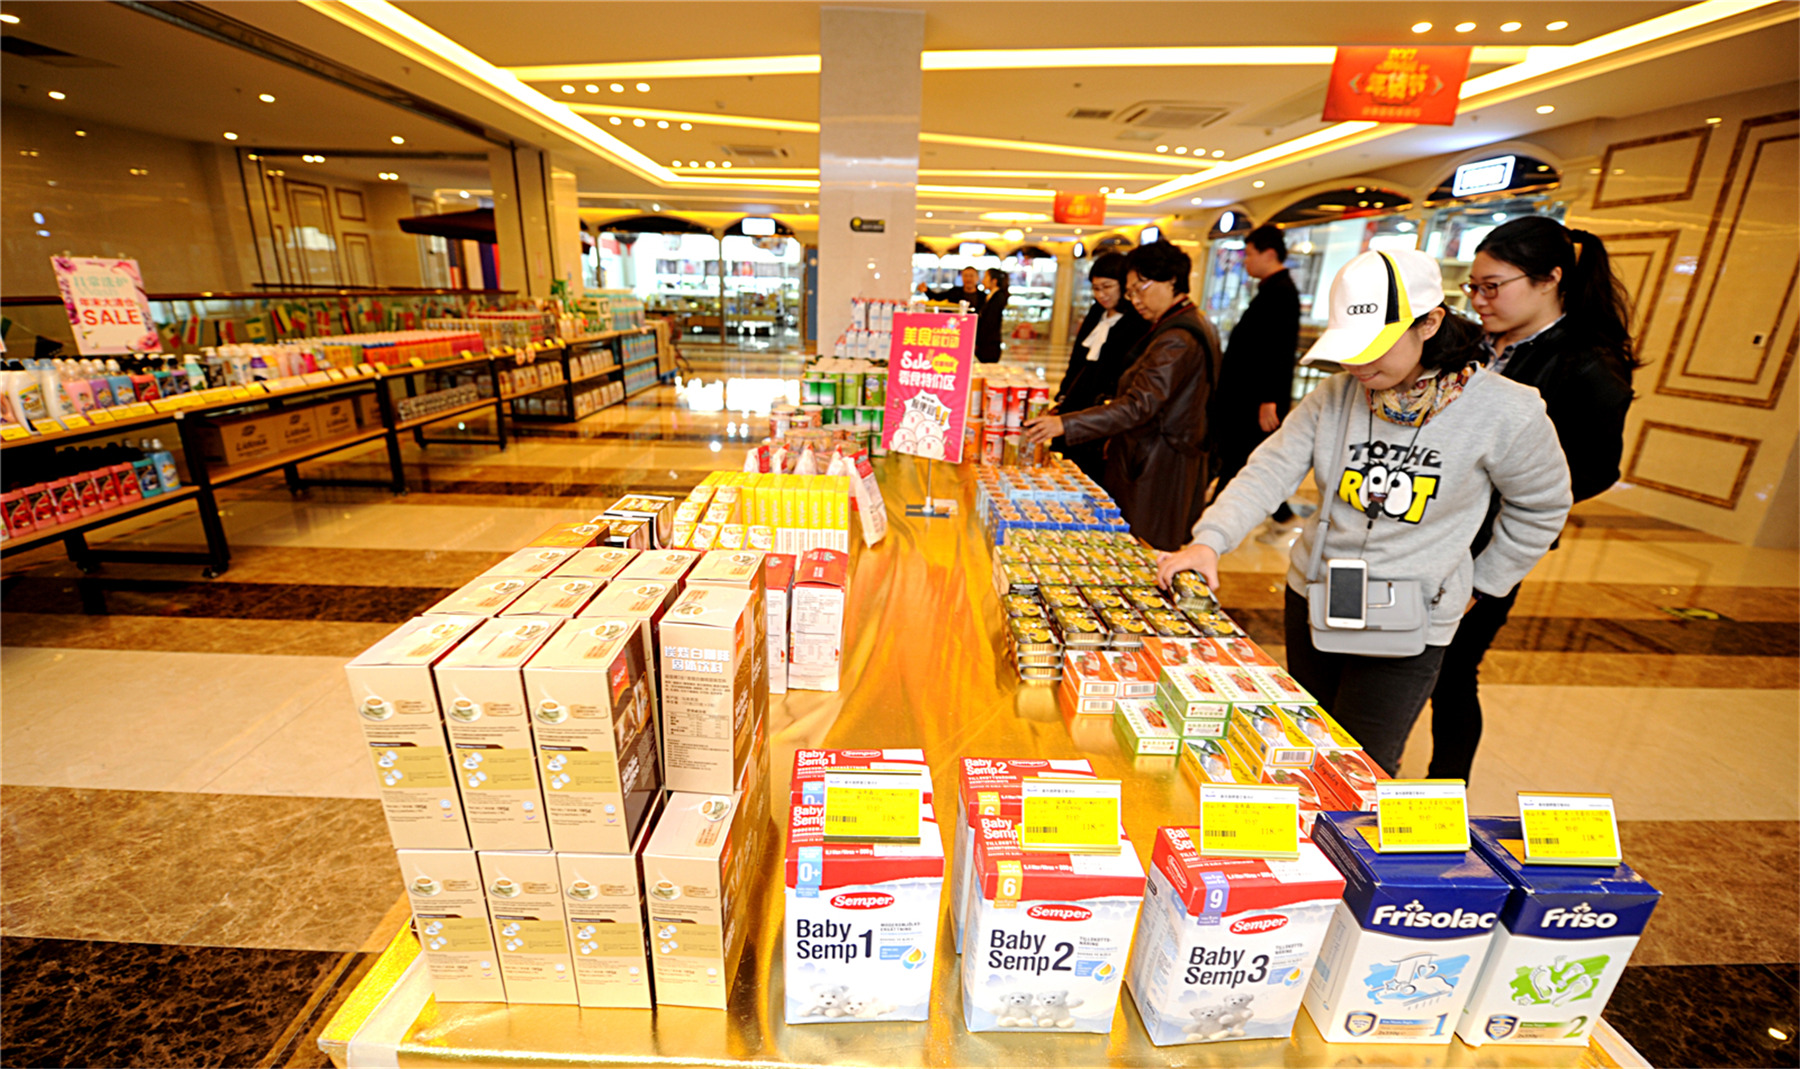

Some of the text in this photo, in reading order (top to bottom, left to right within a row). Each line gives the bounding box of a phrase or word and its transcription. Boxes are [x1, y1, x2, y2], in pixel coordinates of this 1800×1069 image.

[83, 309, 141, 326] SALE
[902, 326, 932, 346] 美食
[1337, 466, 1441, 525] ROOT
[798, 750, 826, 759] Baby
[798, 753, 836, 766] Semp 1
[964, 758, 992, 768] Baby
[966, 762, 1009, 776] Semp 2
[981, 818, 1012, 830] Baby
[799, 862, 821, 882] 0+
[1003, 878, 1016, 896] 6
[833, 895, 893, 908] Semper
[1209, 889, 1223, 909] 9
[1030, 906, 1091, 920] Semper
[1372, 901, 1498, 929] Frisolac
[1541, 904, 1618, 929] Friso
[796, 919, 852, 943] Baby
[1232, 916, 1288, 933] Semper
[796, 929, 873, 964] Semp 1
[990, 929, 1046, 955] Baby
[988, 942, 1075, 976] Semp 2
[1189, 946, 1245, 970] Baby
[1184, 955, 1270, 989] Semp 3
[1429, 1012, 1449, 1037] 1
[1563, 1015, 1588, 1038] 2
